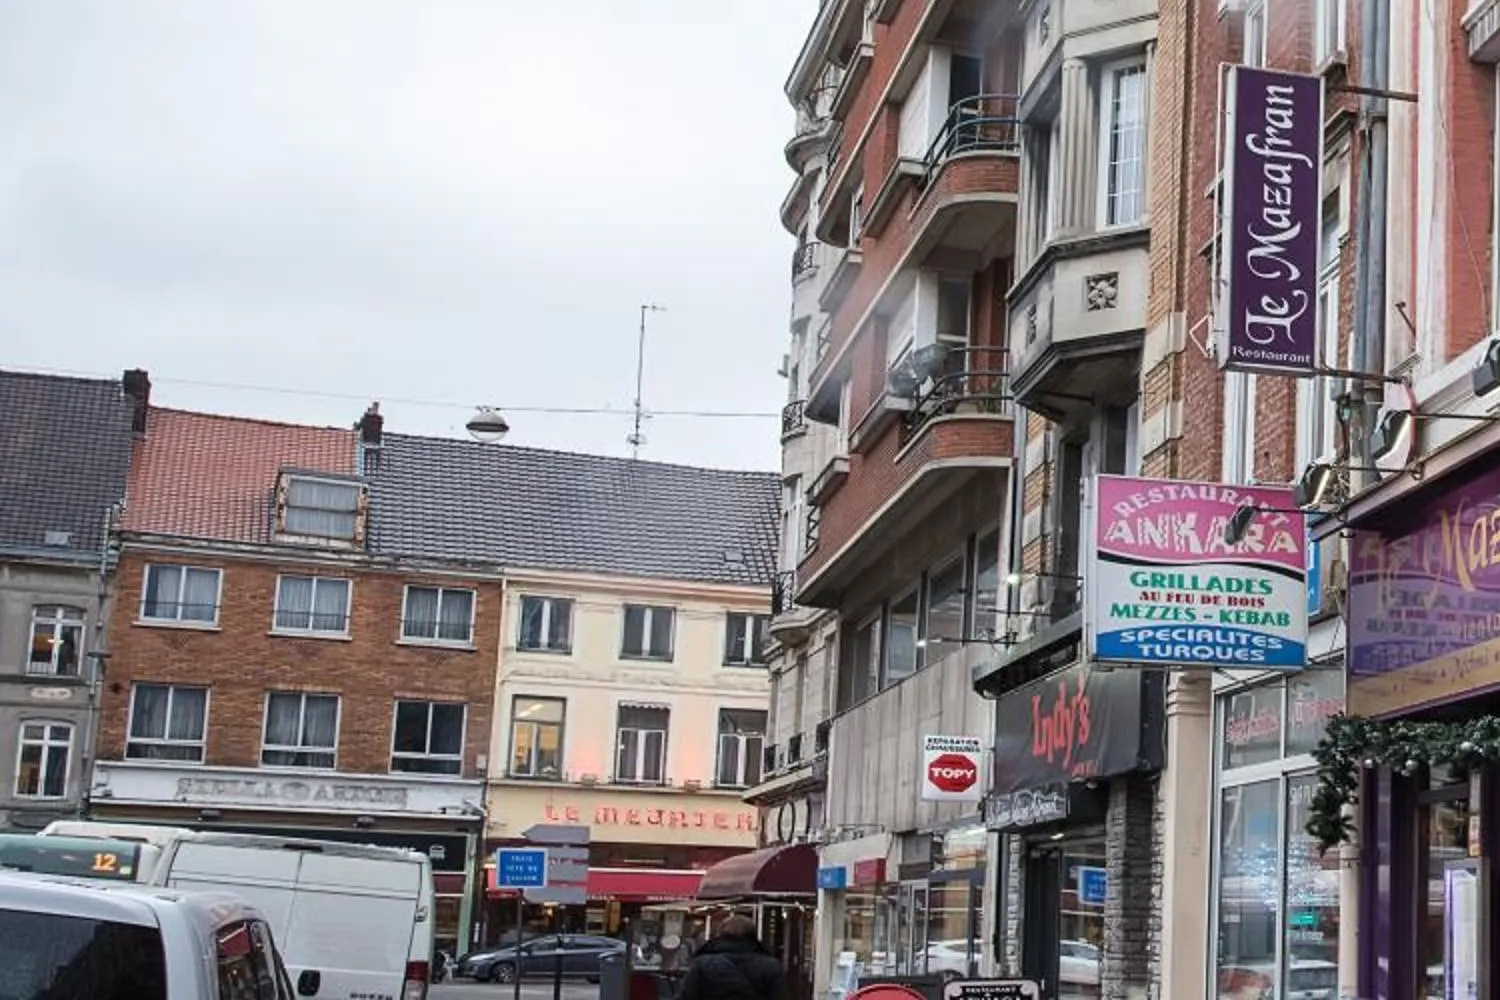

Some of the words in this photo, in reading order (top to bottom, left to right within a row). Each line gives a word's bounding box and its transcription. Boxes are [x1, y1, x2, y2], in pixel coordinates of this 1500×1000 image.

[1245, 85, 1313, 281] Mazafran
[1245, 288, 1309, 345] Le
[1232, 345, 1311, 364] Restaurant
[1114, 485, 1290, 527] RESTAURANT
[1103, 511, 1299, 554] ANKARA
[1130, 571, 1273, 595] GRILLADES
[1139, 591, 1161, 602] AU
[1166, 592, 1195, 604] FEU
[1200, 595, 1219, 605] DE
[1226, 596, 1265, 608] BOIS
[1110, 603, 1197, 622] MEZZES
[1219, 609, 1291, 627] KEBAB
[1120, 627, 1283, 650] SPECIALITES
[1138, 644, 1266, 662] TURQUES
[930, 767, 975, 779] TOPY
[543, 805, 580, 822] LE
[91, 852, 118, 872] 12
